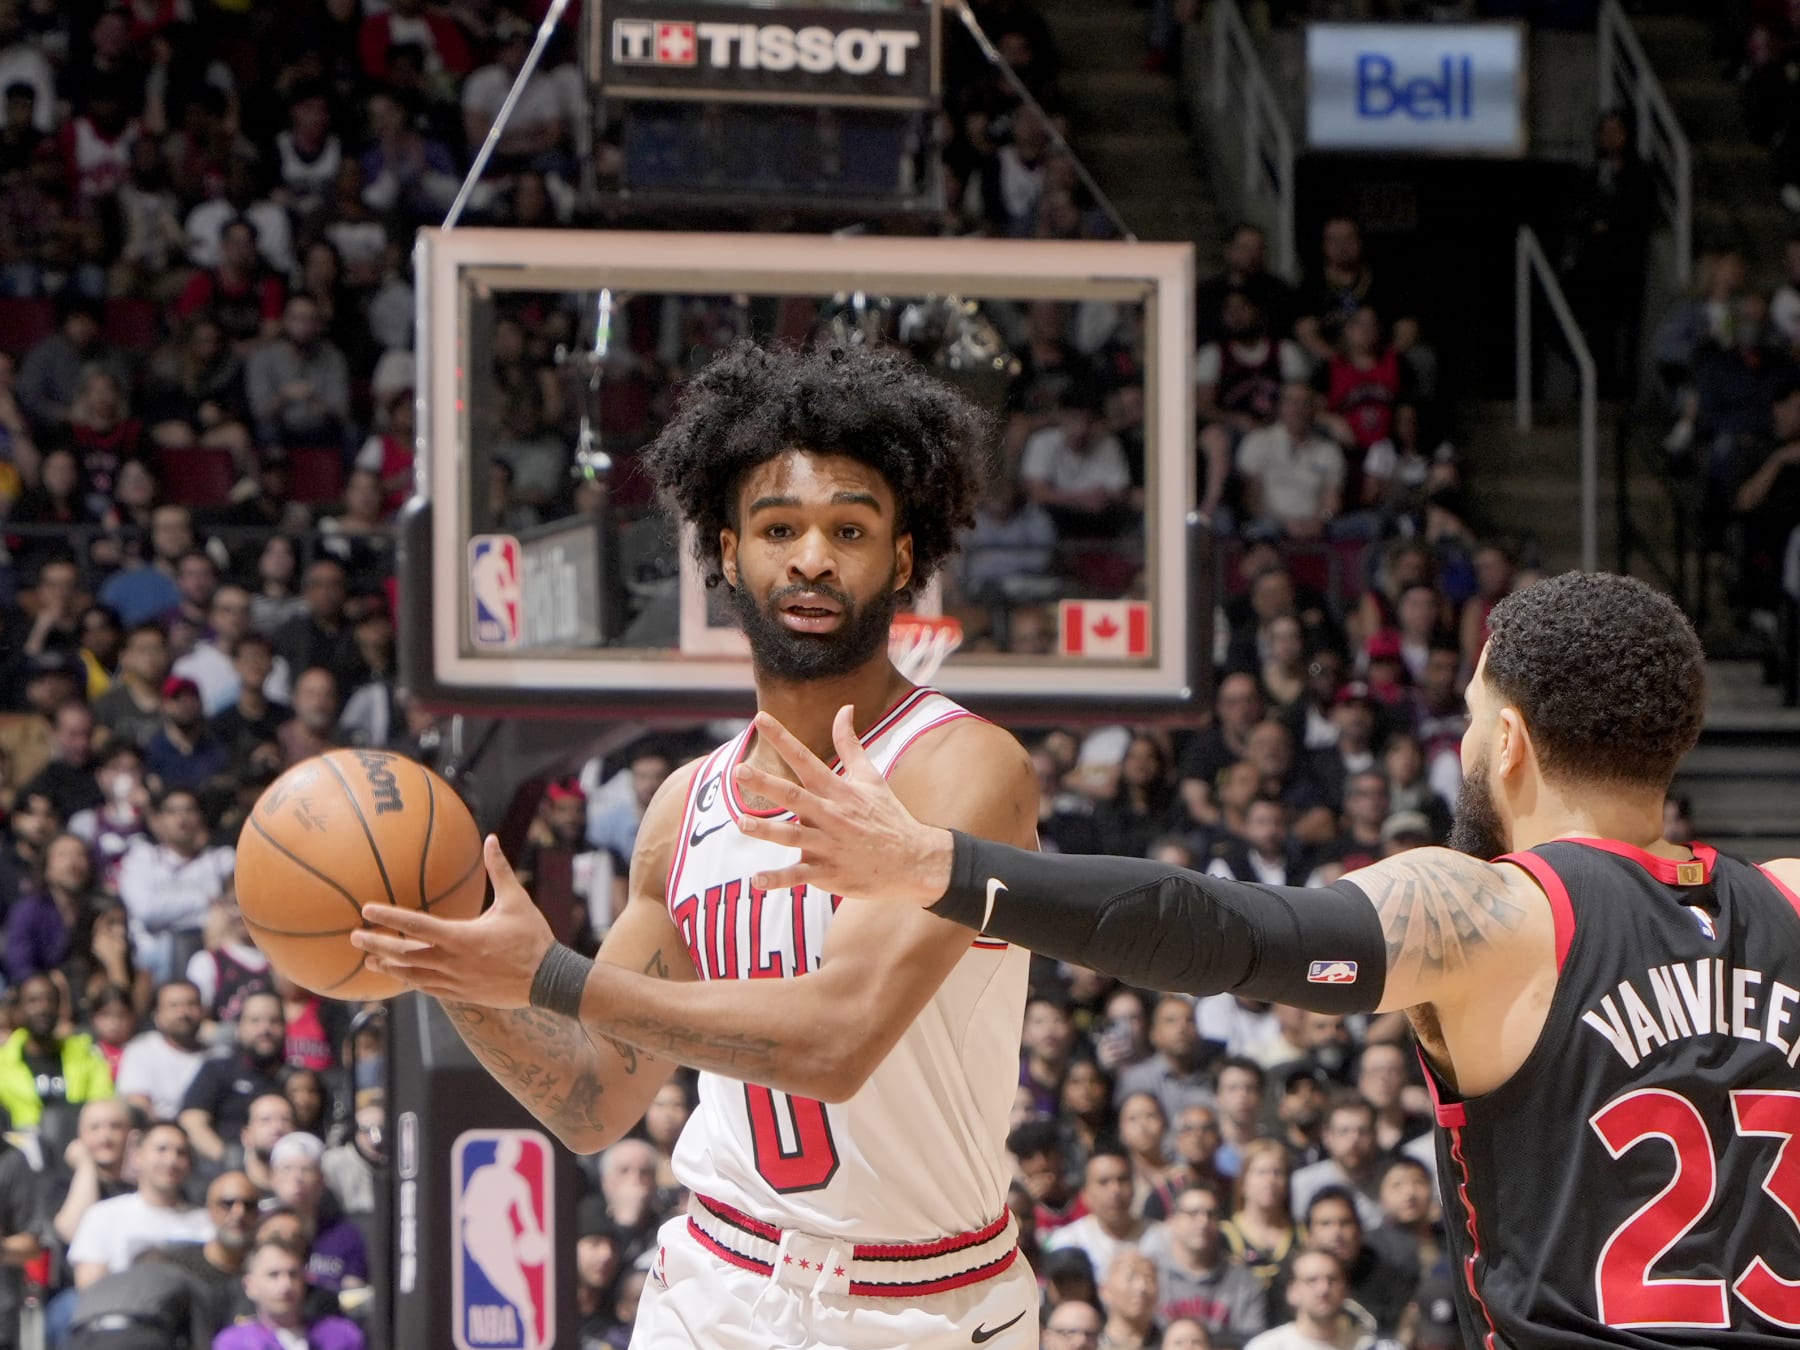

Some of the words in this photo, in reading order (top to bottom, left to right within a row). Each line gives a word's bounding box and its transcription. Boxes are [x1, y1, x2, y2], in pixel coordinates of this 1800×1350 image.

[698, 23, 920, 75] TISSOT
[1356, 54, 1470, 119] Bell
[675, 876, 843, 980] BULL
[1582, 958, 1800, 1069] VANVLEE
[469, 1304, 518, 1341] NBA
